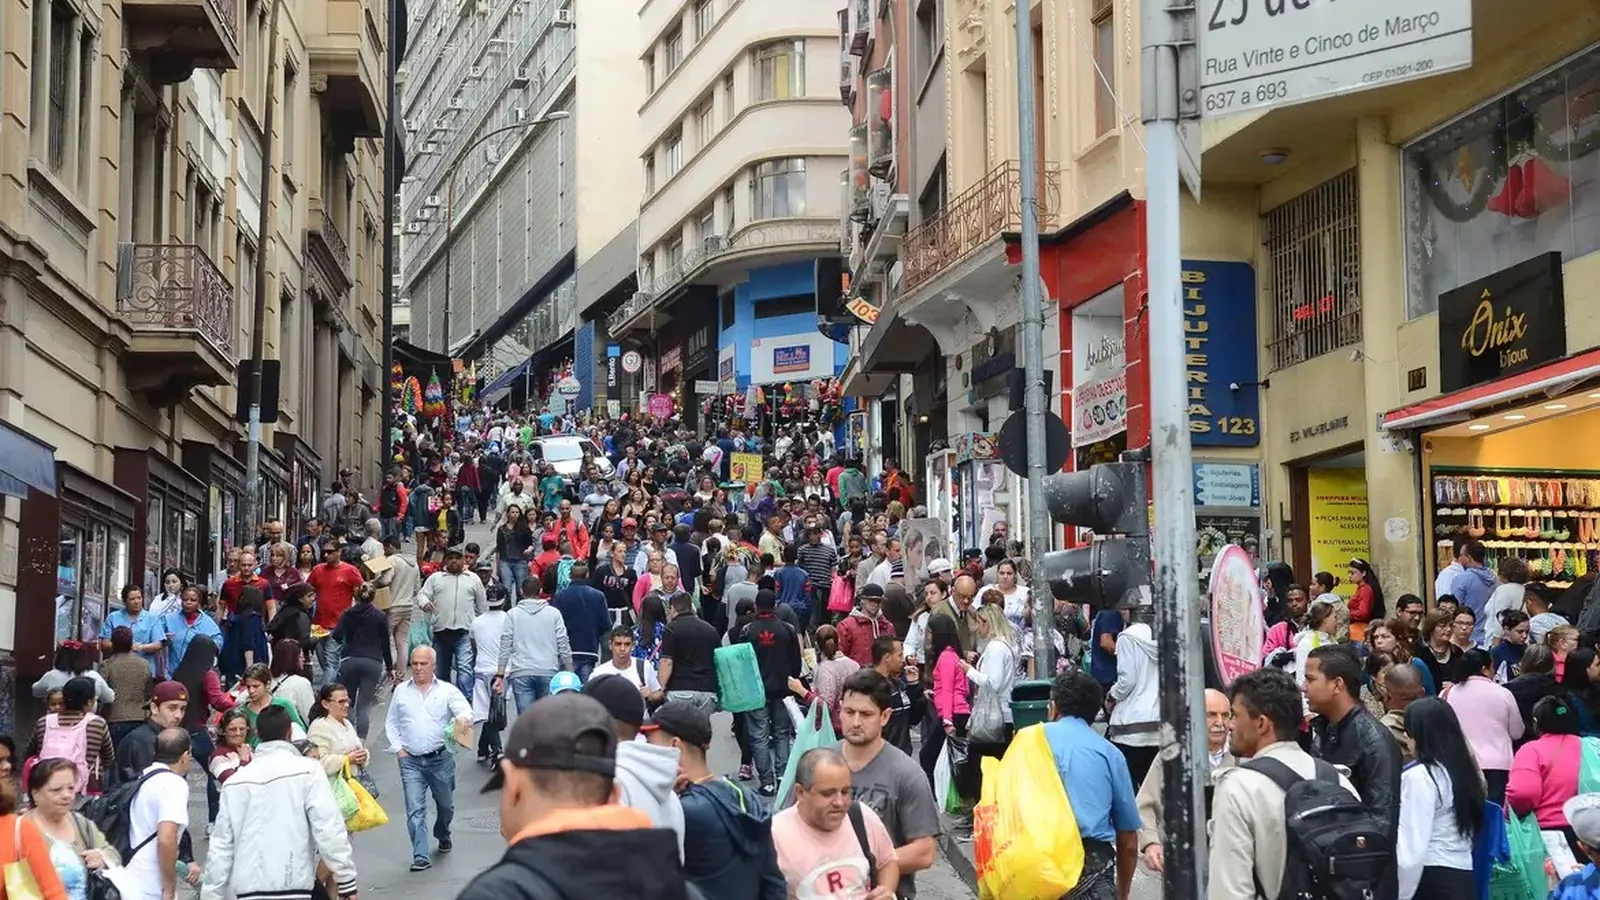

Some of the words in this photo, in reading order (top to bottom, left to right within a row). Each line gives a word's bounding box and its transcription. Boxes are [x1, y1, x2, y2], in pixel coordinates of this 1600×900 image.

[1205, 57, 1238, 76] Rua
[1243, 48, 1285, 69] Vinte
[1289, 47, 1300, 58] e
[1304, 31, 1353, 56] Cinco
[1357, 24, 1380, 44] de
[1384, 9, 1440, 37] Março
[1362, 70, 1384, 83] CEP
[1385, 59, 1435, 81] 01021-200
[1206, 90, 1236, 112] 637
[1240, 91, 1251, 104] a
[1256, 80, 1288, 101] 693
[852, 300, 880, 323] 103
[1462, 288, 1528, 356] Ônix
[1181, 270, 1212, 433] BIJUTERIAS
[1500, 348, 1529, 368] bijoux
[1217, 416, 1256, 435] 123
